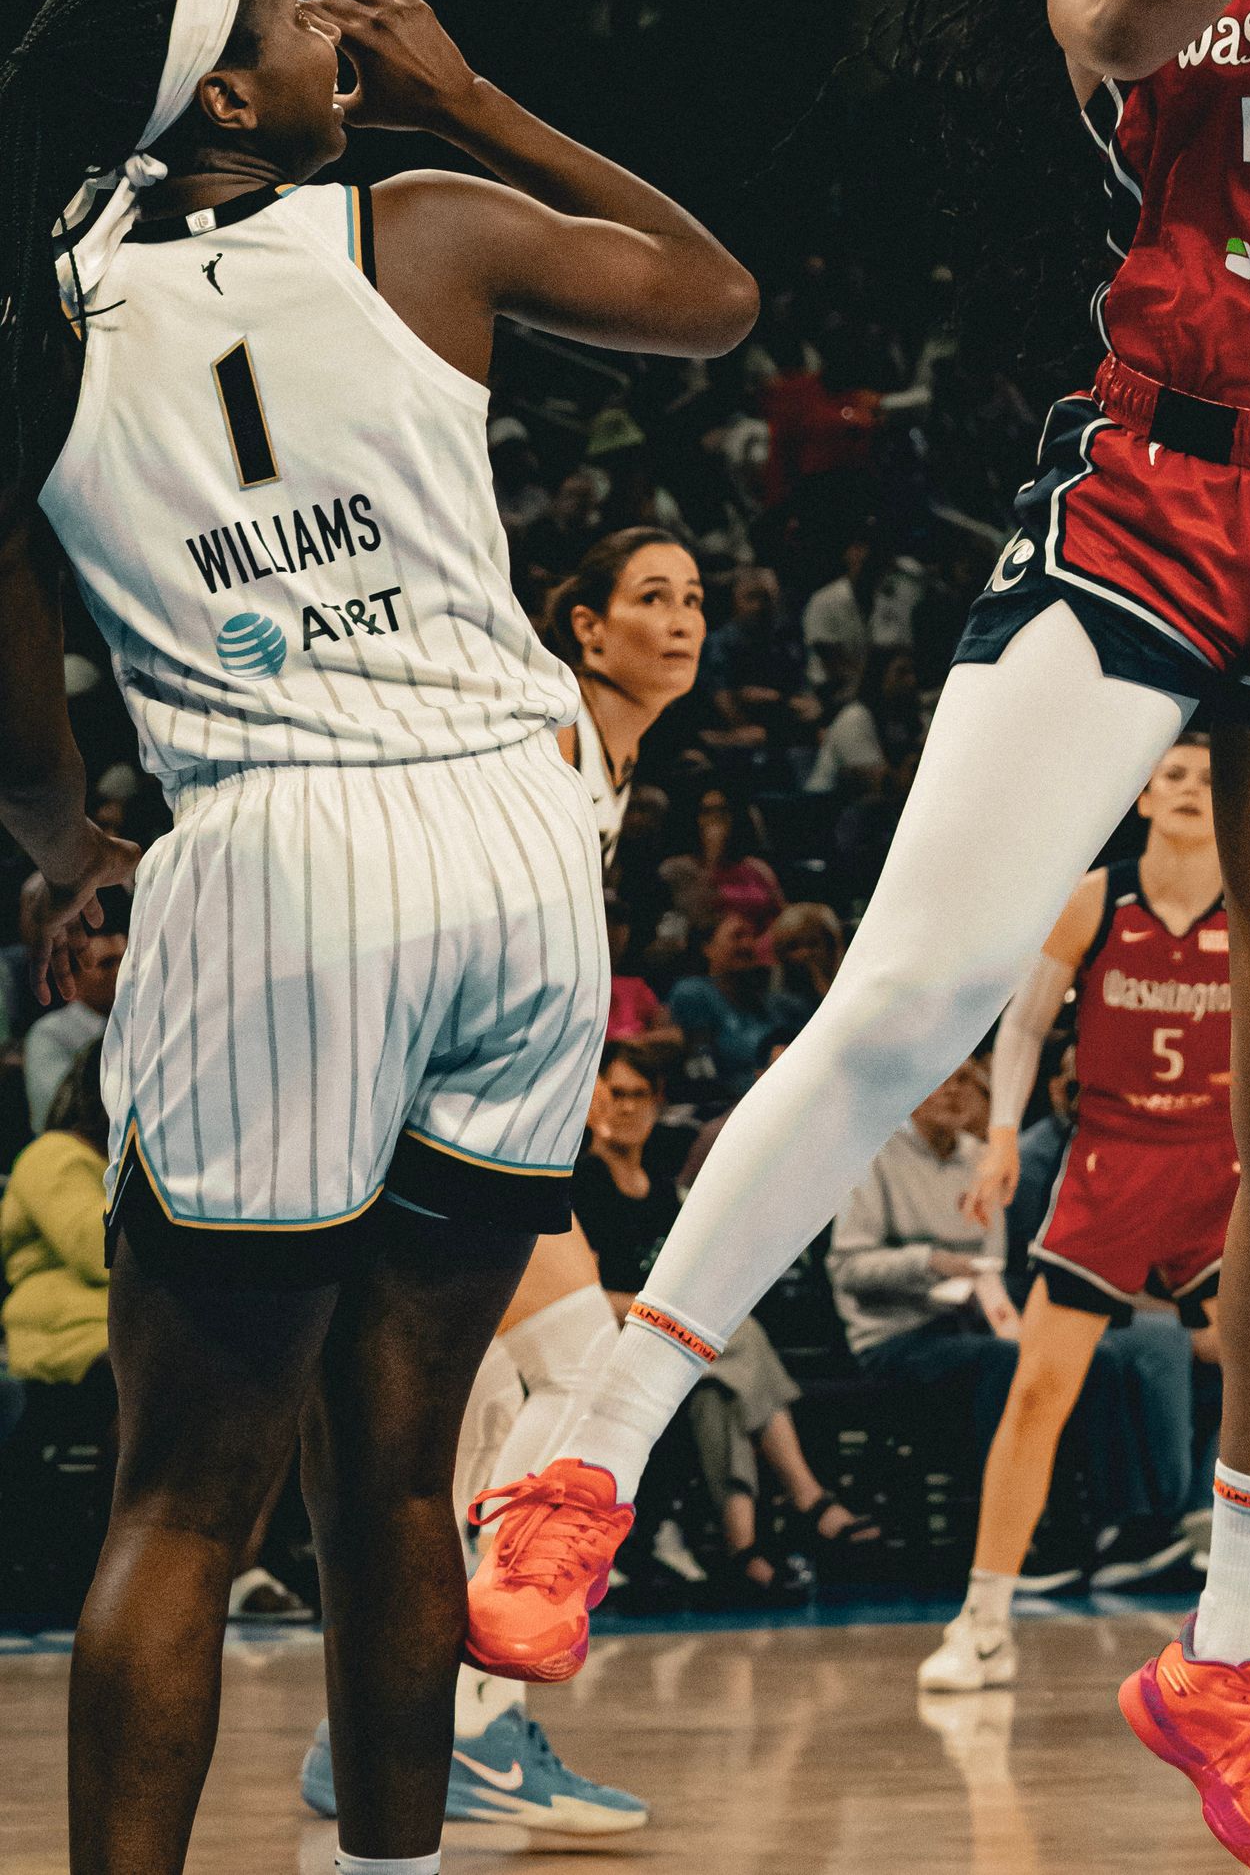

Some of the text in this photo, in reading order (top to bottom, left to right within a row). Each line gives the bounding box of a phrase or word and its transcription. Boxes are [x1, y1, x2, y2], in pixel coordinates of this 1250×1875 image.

[210, 334, 282, 492] 1
[186, 493, 381, 594] WILLIAMS
[302, 586, 401, 651] AT&T
[1153, 1028, 1184, 1081] 5
